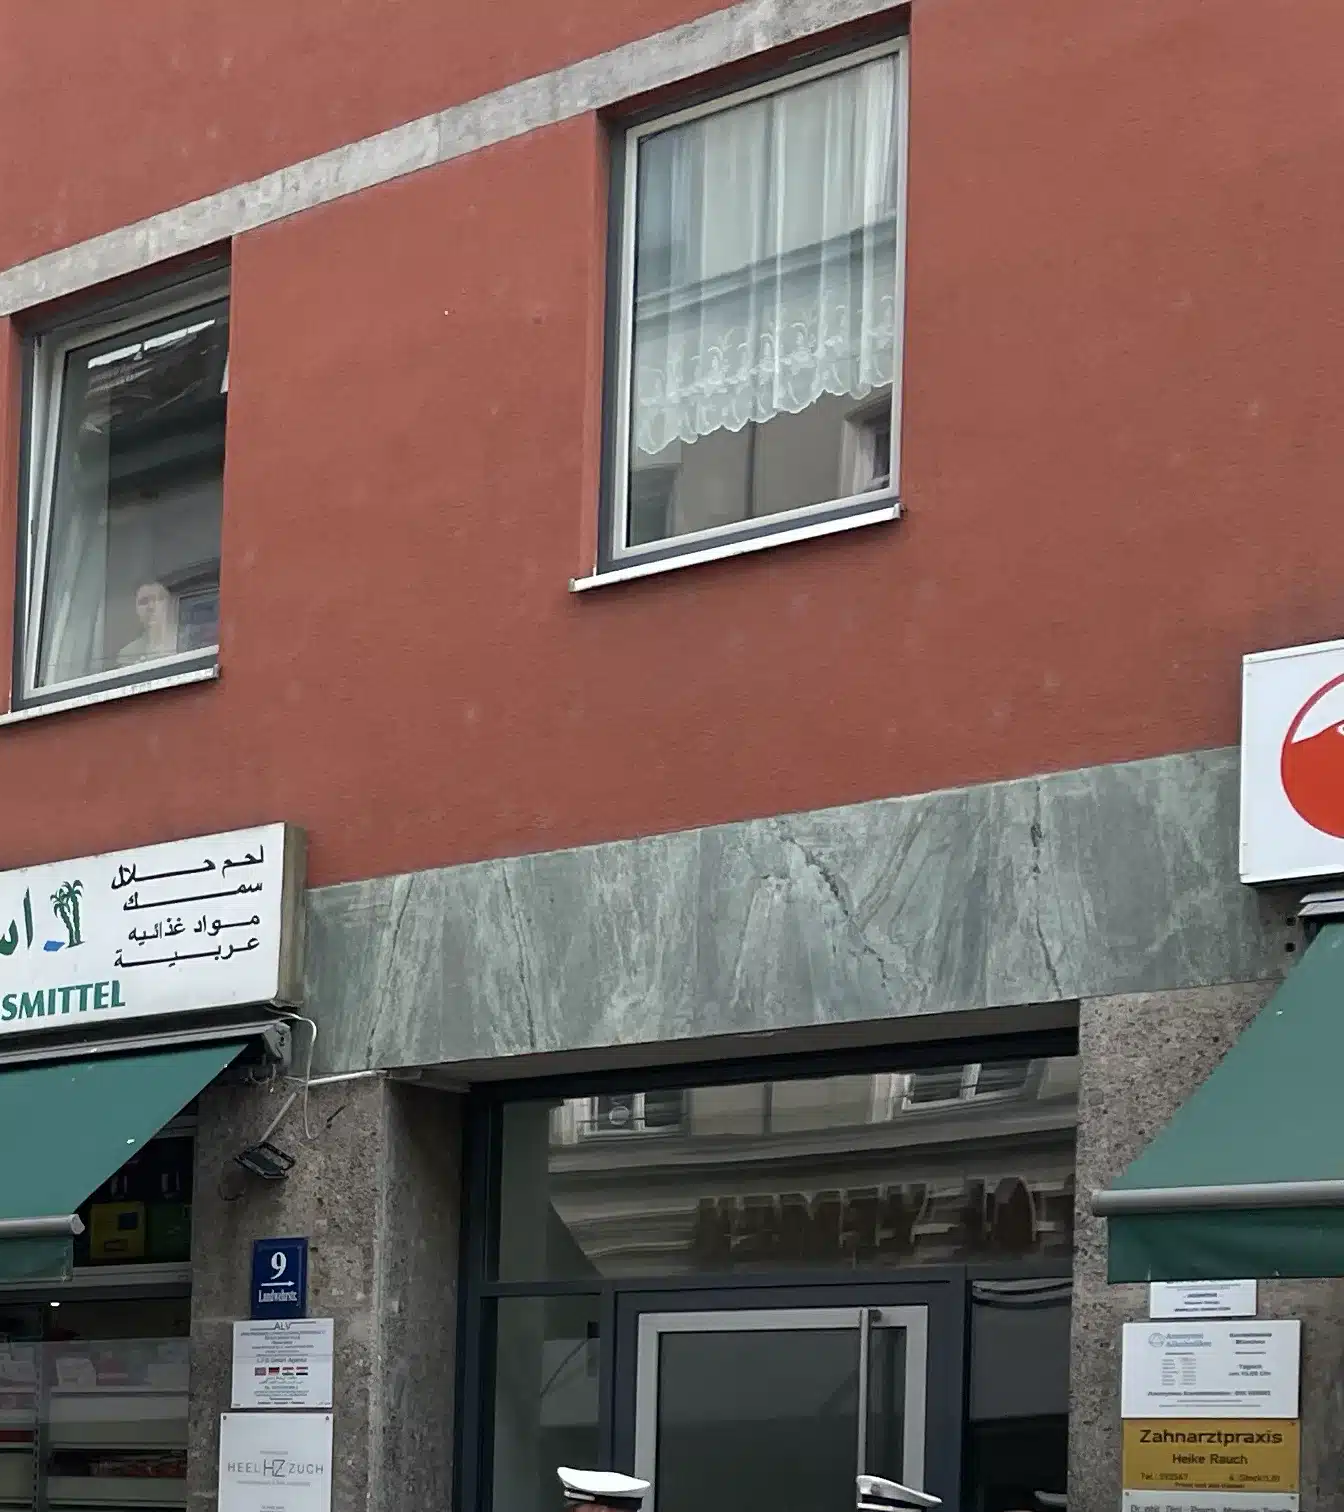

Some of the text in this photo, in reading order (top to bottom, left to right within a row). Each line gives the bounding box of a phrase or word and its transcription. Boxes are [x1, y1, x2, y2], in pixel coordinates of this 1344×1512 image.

[222, 844, 265, 879] لحم
[270, 1251, 287, 1281] 9
[1139, 1428, 1283, 1448] Zahnarztpraxis
[1172, 1453, 1249, 1465] Heike Rauch
